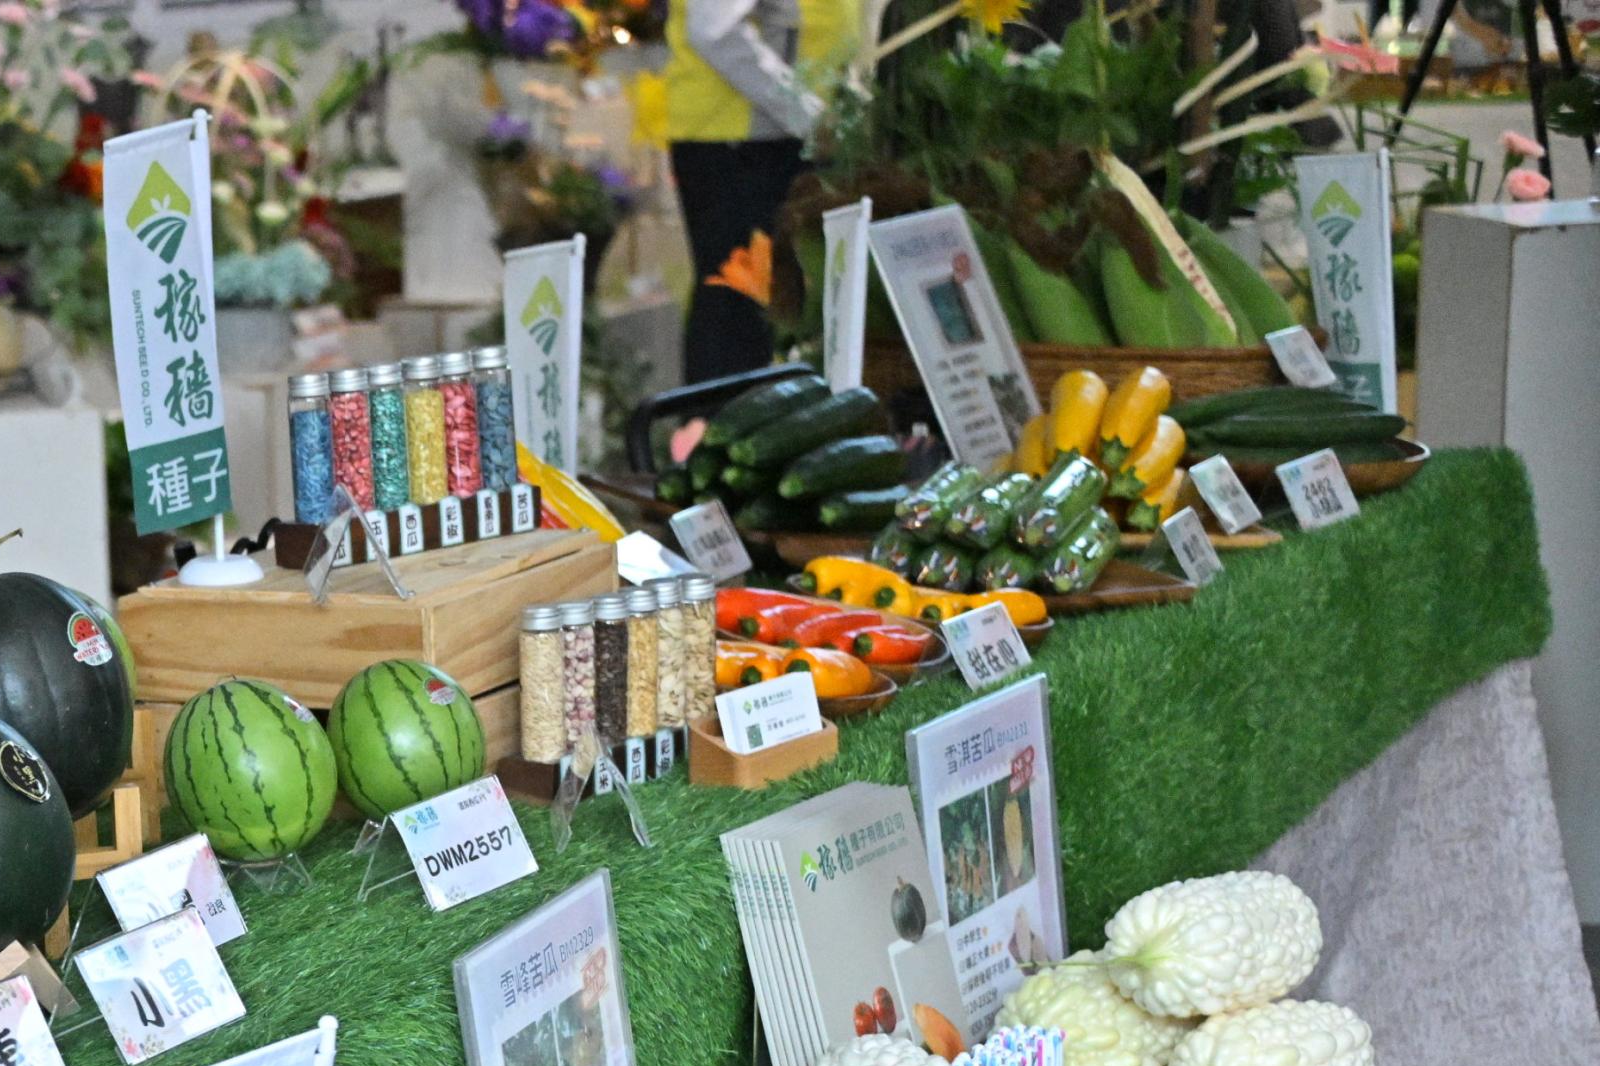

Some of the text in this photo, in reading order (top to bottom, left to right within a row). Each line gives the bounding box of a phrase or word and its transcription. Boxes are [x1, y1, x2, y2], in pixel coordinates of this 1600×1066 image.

[146, 447, 228, 517] 種子
[405, 514, 418, 547] 西瓜
[424, 825, 512, 877] DWM2557
[500, 942, 558, 1009] 雪峰苦瓜
[559, 926, 594, 966] BM2329
